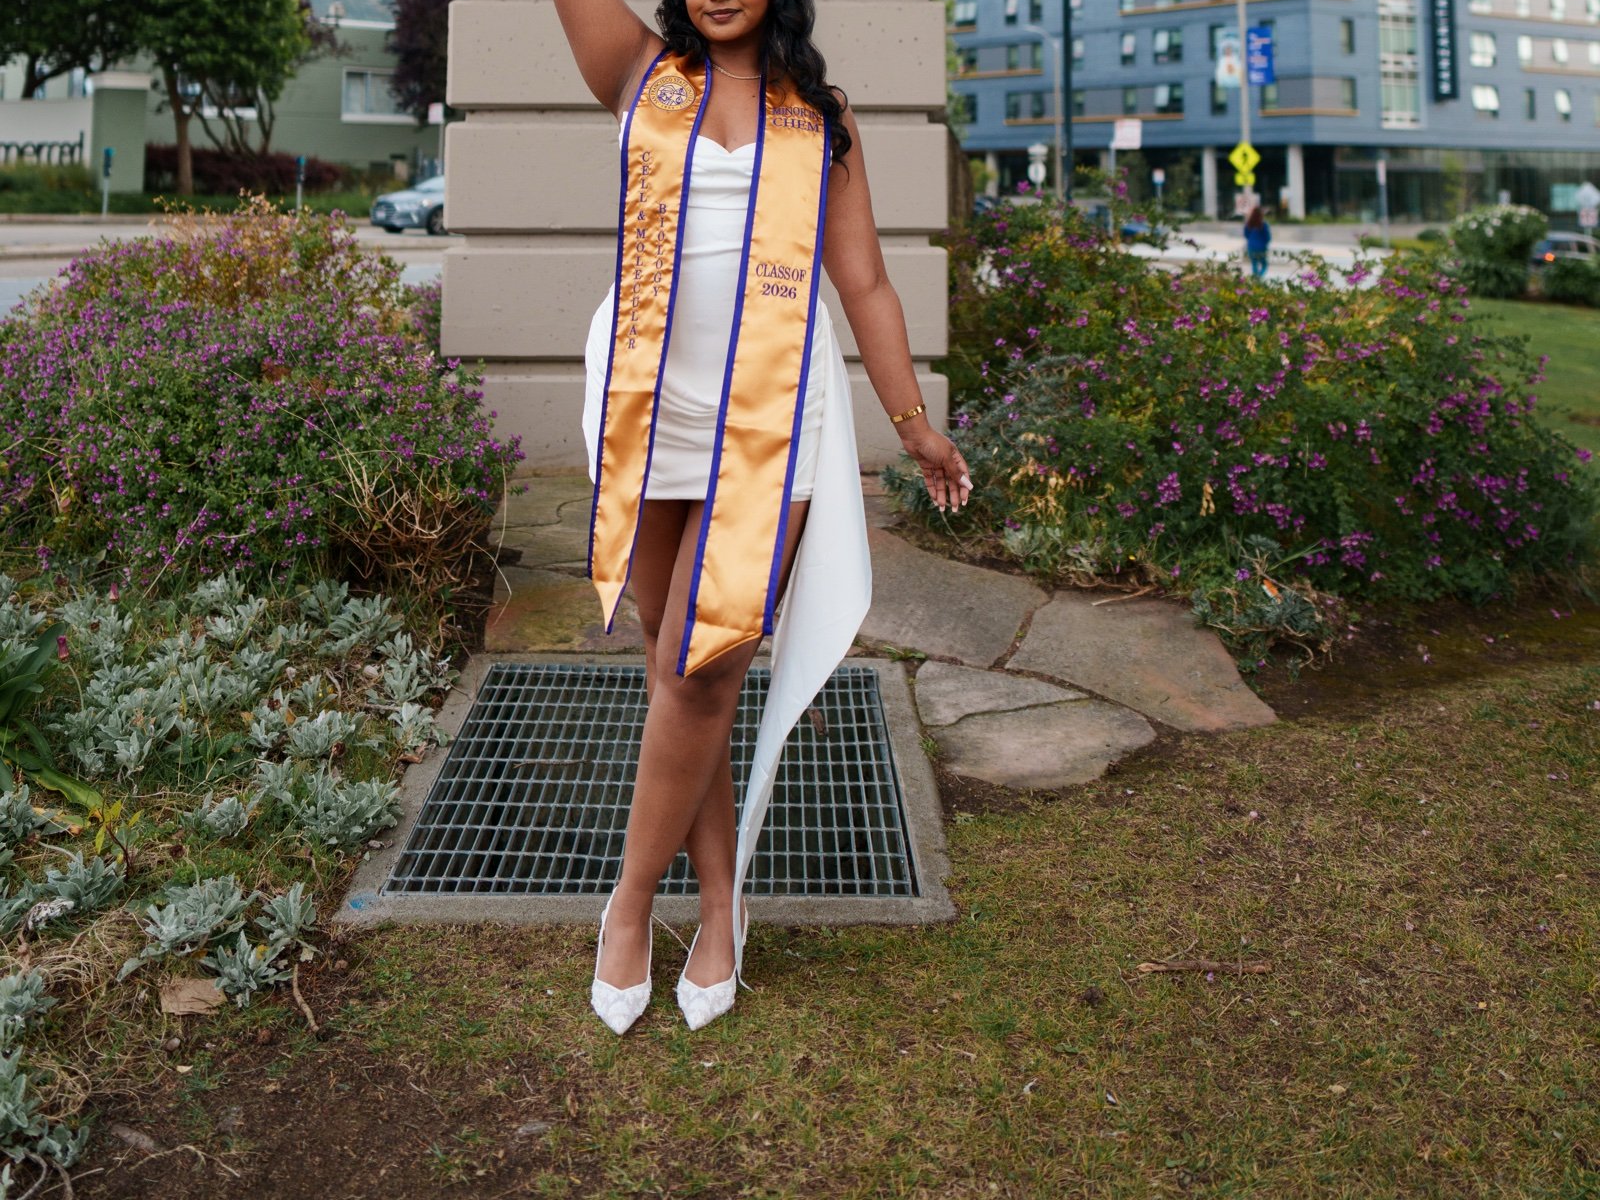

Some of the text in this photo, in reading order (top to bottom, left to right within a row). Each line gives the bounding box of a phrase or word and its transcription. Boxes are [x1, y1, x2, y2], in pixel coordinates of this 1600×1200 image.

[772, 106, 808, 117] MINOR
[772, 117, 819, 132] CHEM
[628, 152, 650, 349] CELL & MOLECULAR
[653, 203, 667, 297] BIOLOGY
[756, 264, 806, 282] CLASS OF
[761, 283, 797, 299] 2026
